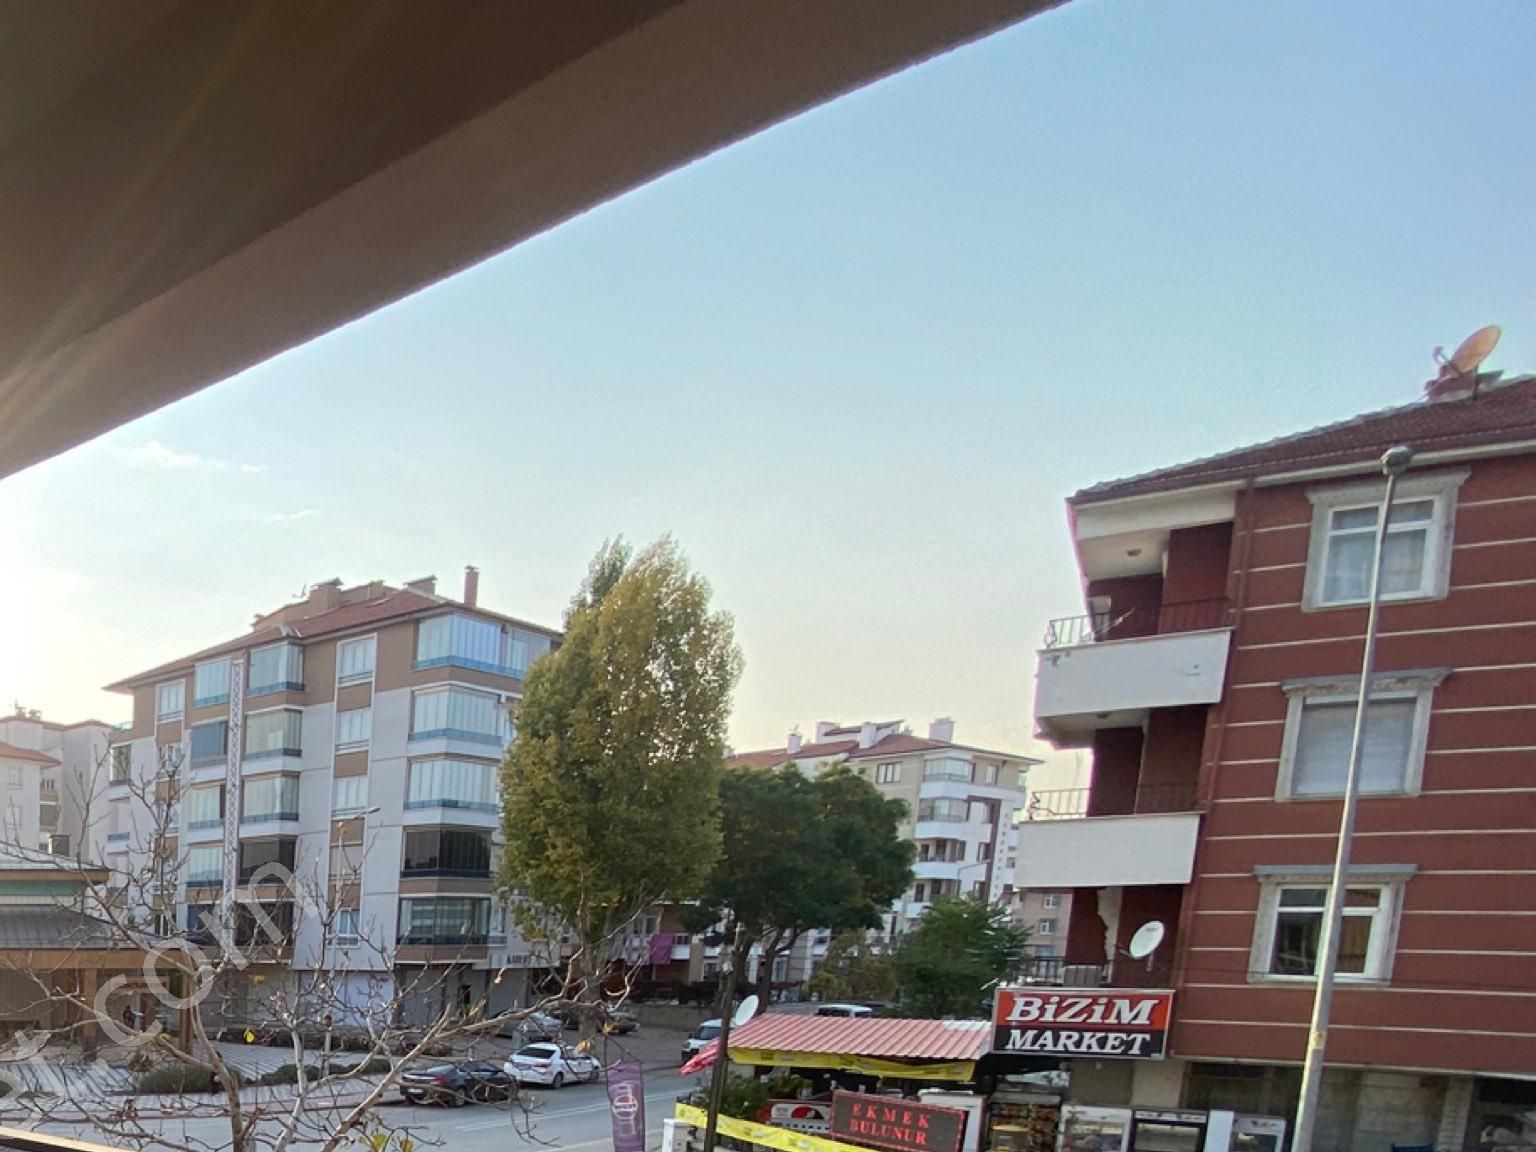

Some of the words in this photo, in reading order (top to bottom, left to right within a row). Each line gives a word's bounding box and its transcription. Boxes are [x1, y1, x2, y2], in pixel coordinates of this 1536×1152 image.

[1004, 1029, 1151, 1055] MARKET
[851, 1103, 930, 1129] EKMEK
[849, 1118, 928, 1145] BULUNUR
